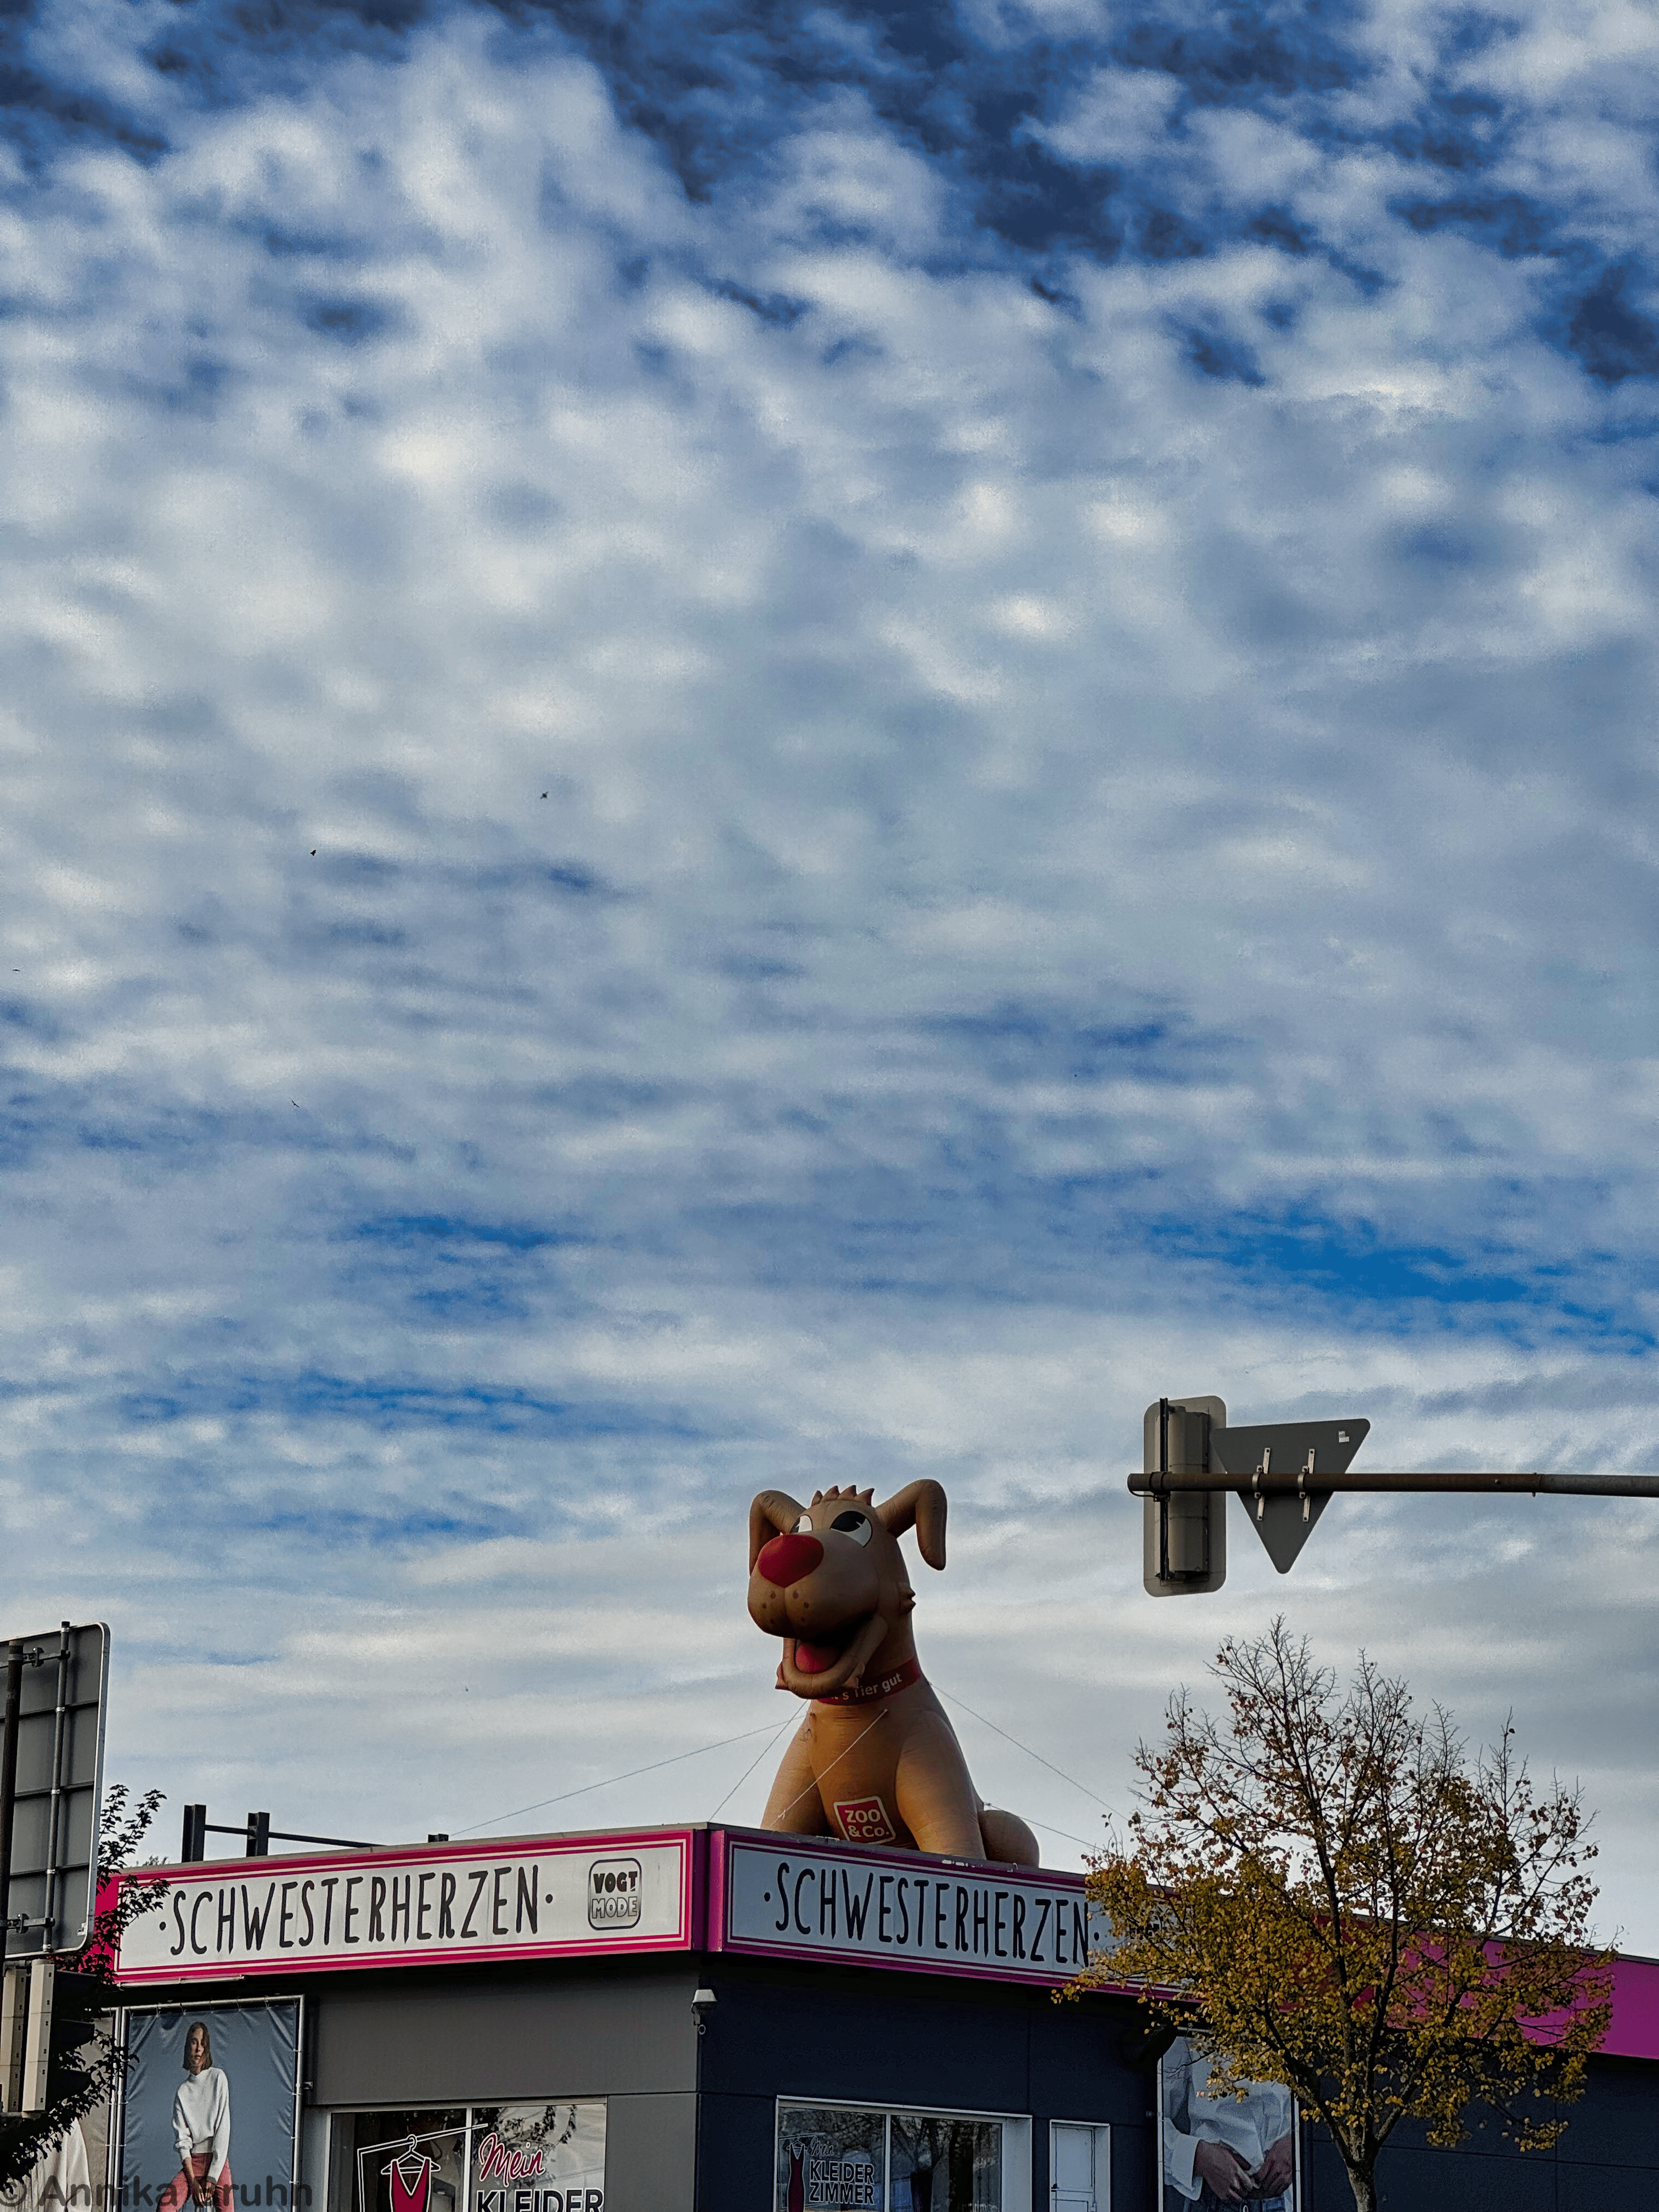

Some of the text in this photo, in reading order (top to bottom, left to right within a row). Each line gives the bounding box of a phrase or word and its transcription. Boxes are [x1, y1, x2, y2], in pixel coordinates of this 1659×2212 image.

[882, 1673, 902, 1692] gut
[845, 1809, 881, 1823] ZOO
[848, 1825, 889, 1837] & Co.
[593, 1871, 637, 1894] VOGT
[592, 1896, 637, 1919] MODE
[478, 2132, 545, 2187] Mein
[810, 2159, 874, 2185] KLEIDER
[809, 2181, 874, 2205] ZIMMER
